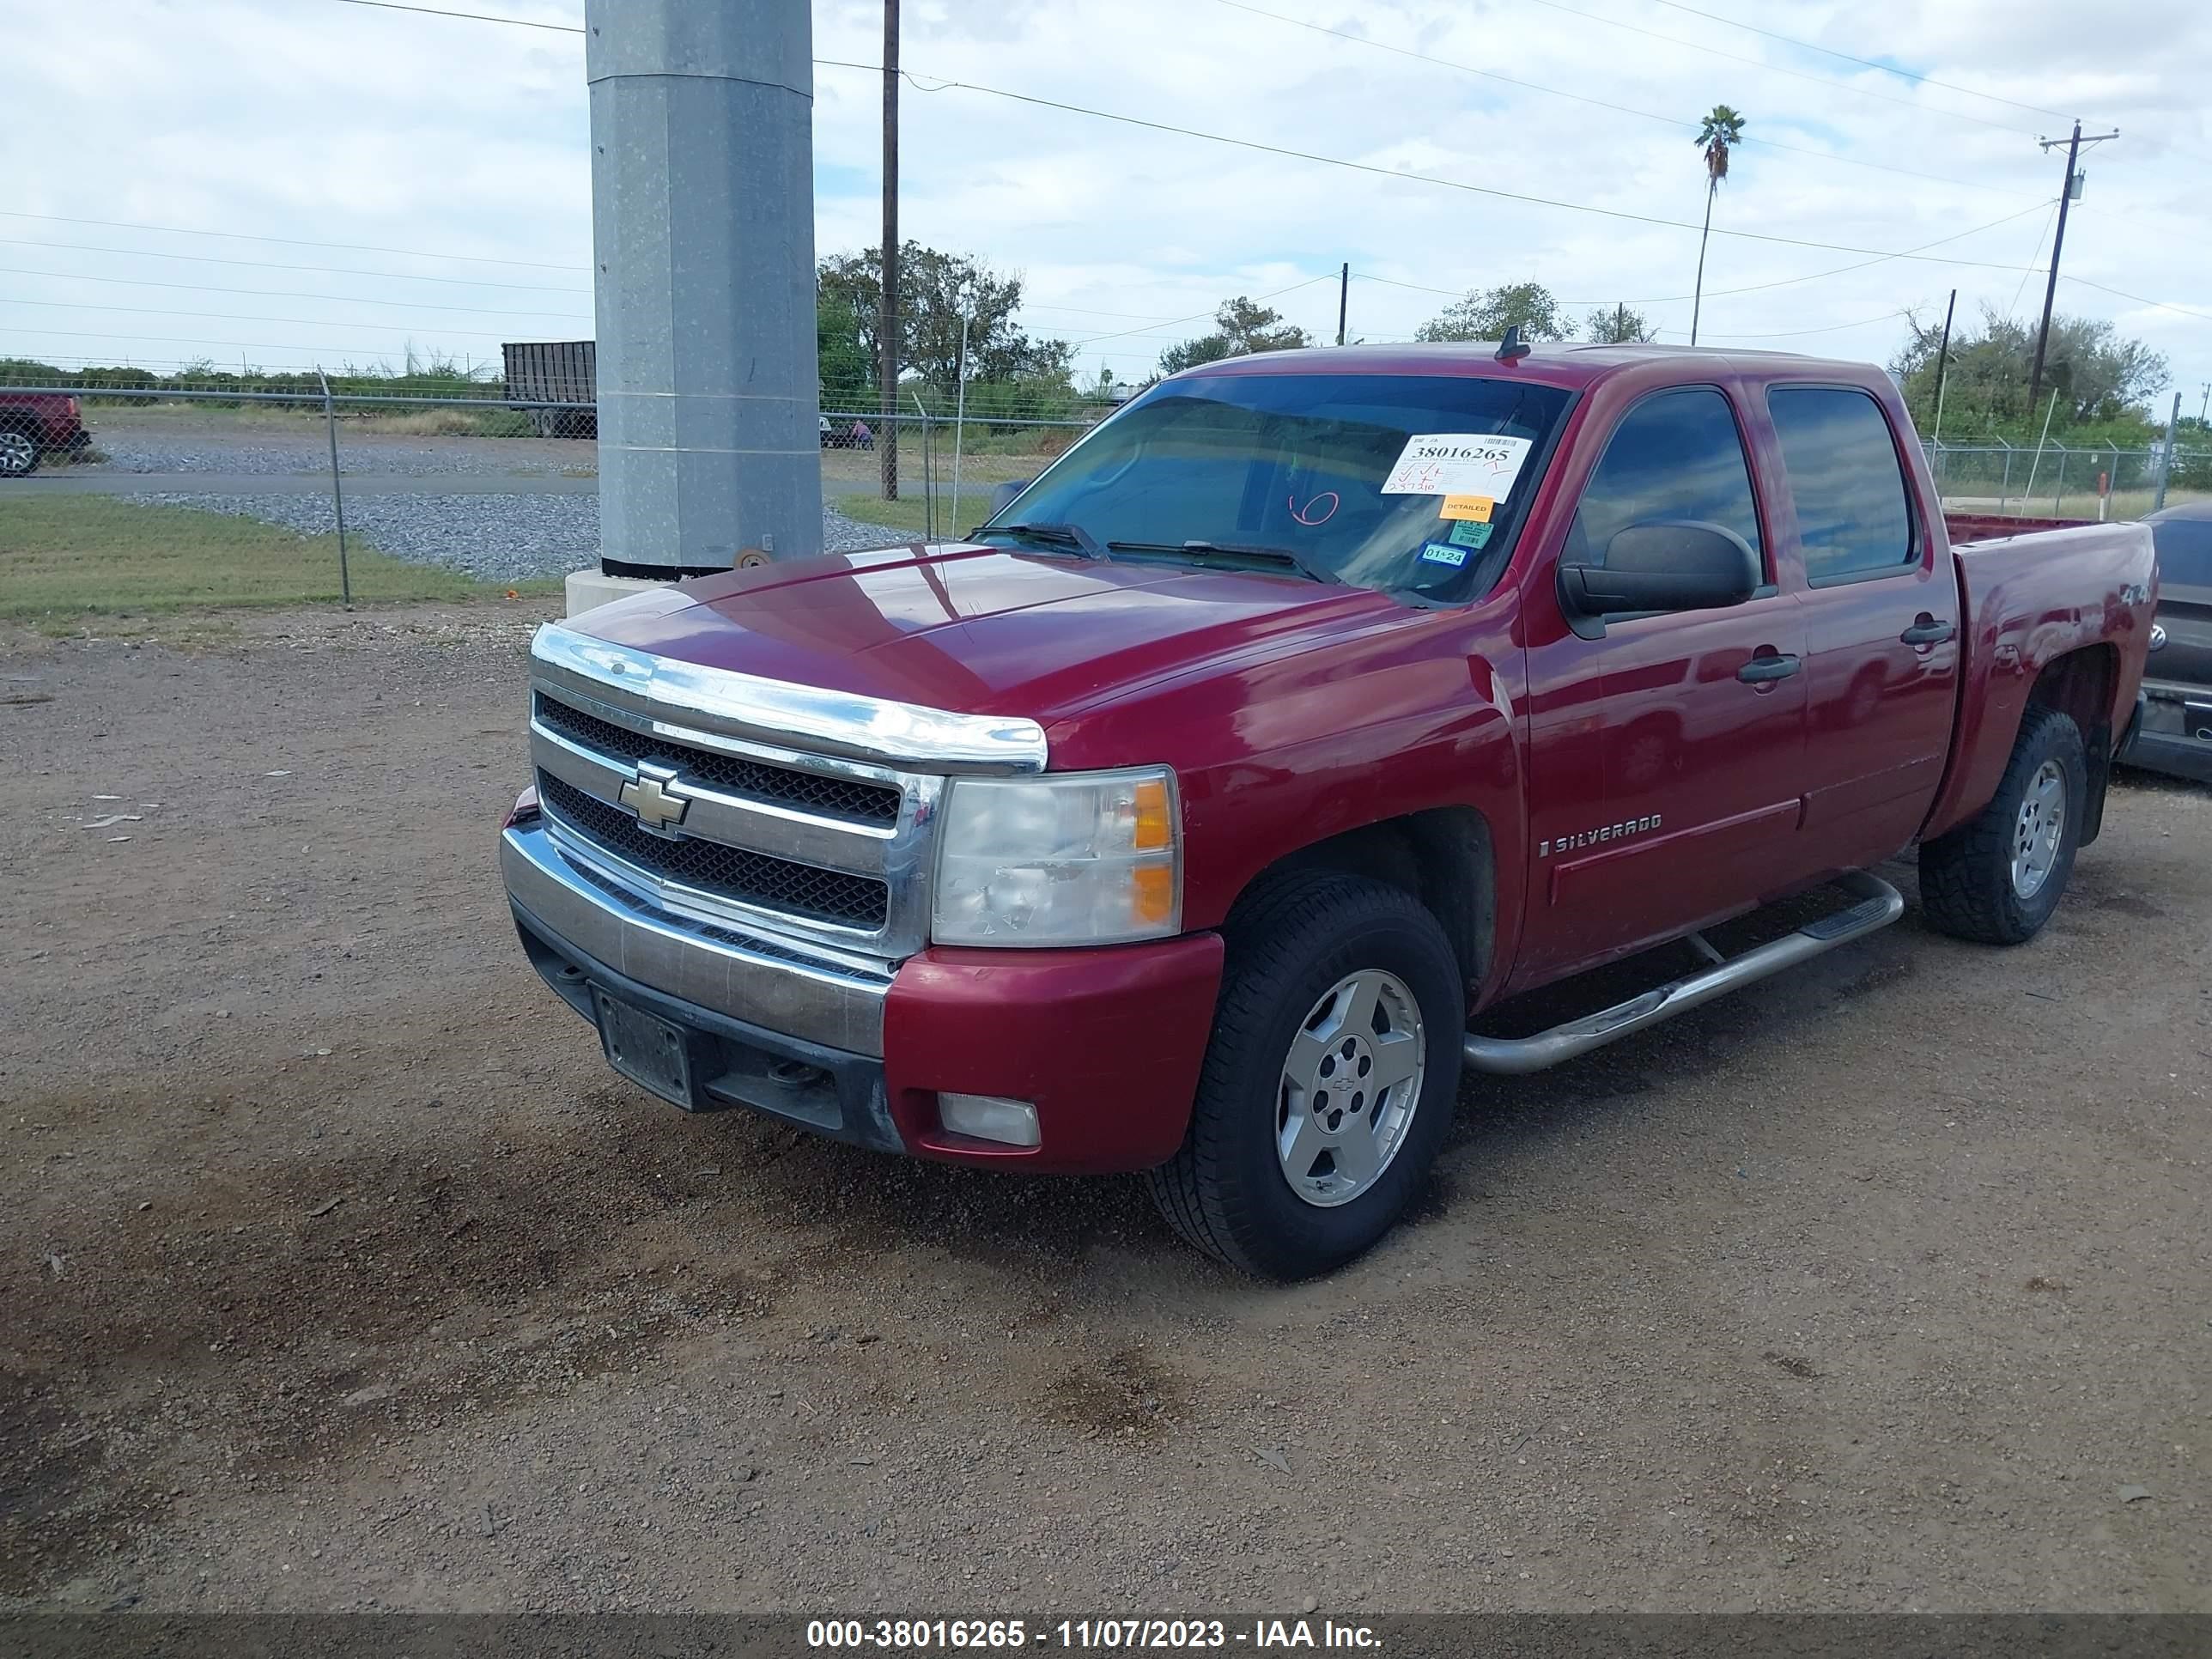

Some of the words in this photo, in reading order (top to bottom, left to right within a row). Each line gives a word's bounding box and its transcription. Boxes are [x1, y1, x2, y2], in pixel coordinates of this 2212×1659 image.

[1411, 446, 1510, 461] 38016265
[1447, 503, 1487, 512] DETAILED
[1555, 814, 1662, 853] SILVERADO
